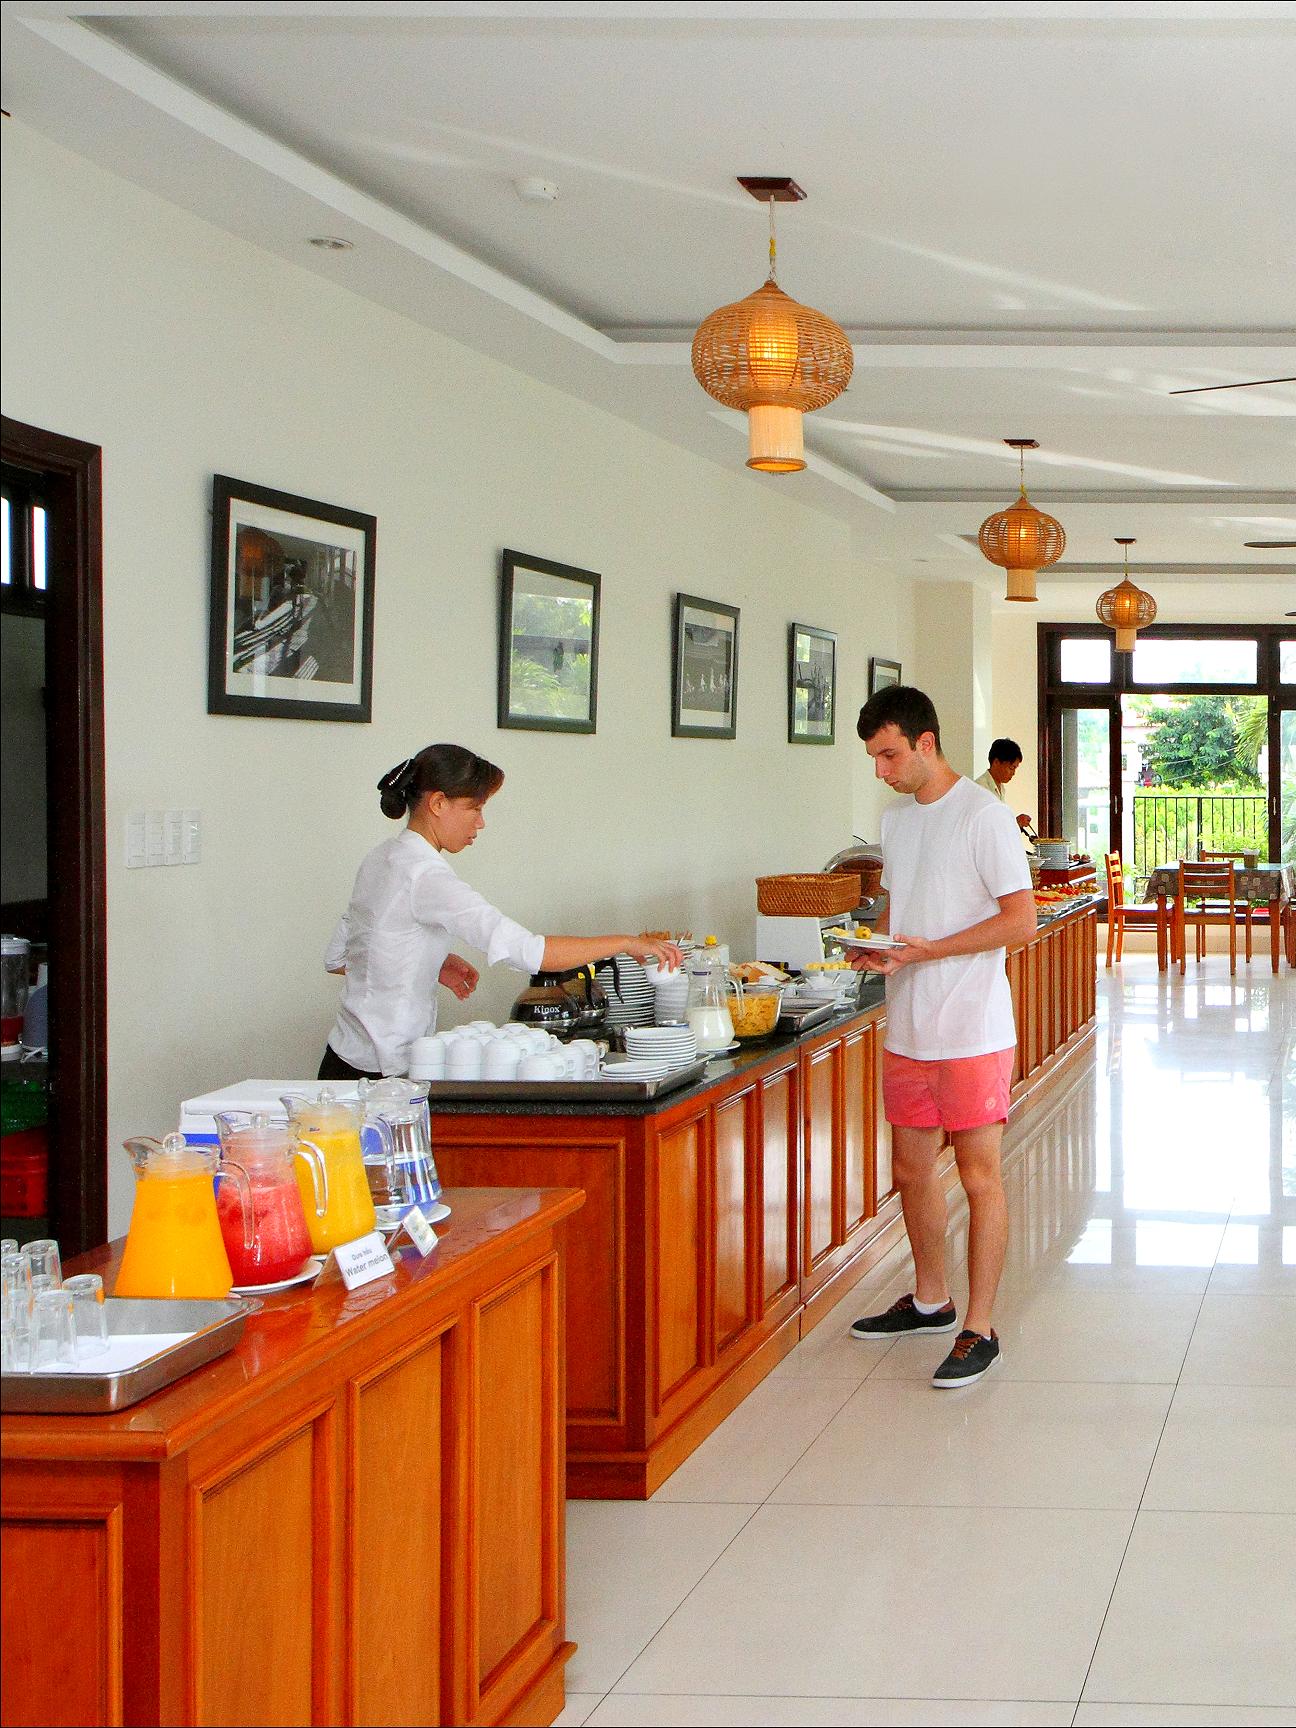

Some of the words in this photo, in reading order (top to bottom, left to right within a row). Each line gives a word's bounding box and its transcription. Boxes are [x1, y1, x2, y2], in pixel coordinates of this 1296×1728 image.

[534, 1005, 561, 1014] Kinox
[345, 1262, 367, 1277] Water
[367, 1253, 389, 1268] melon
